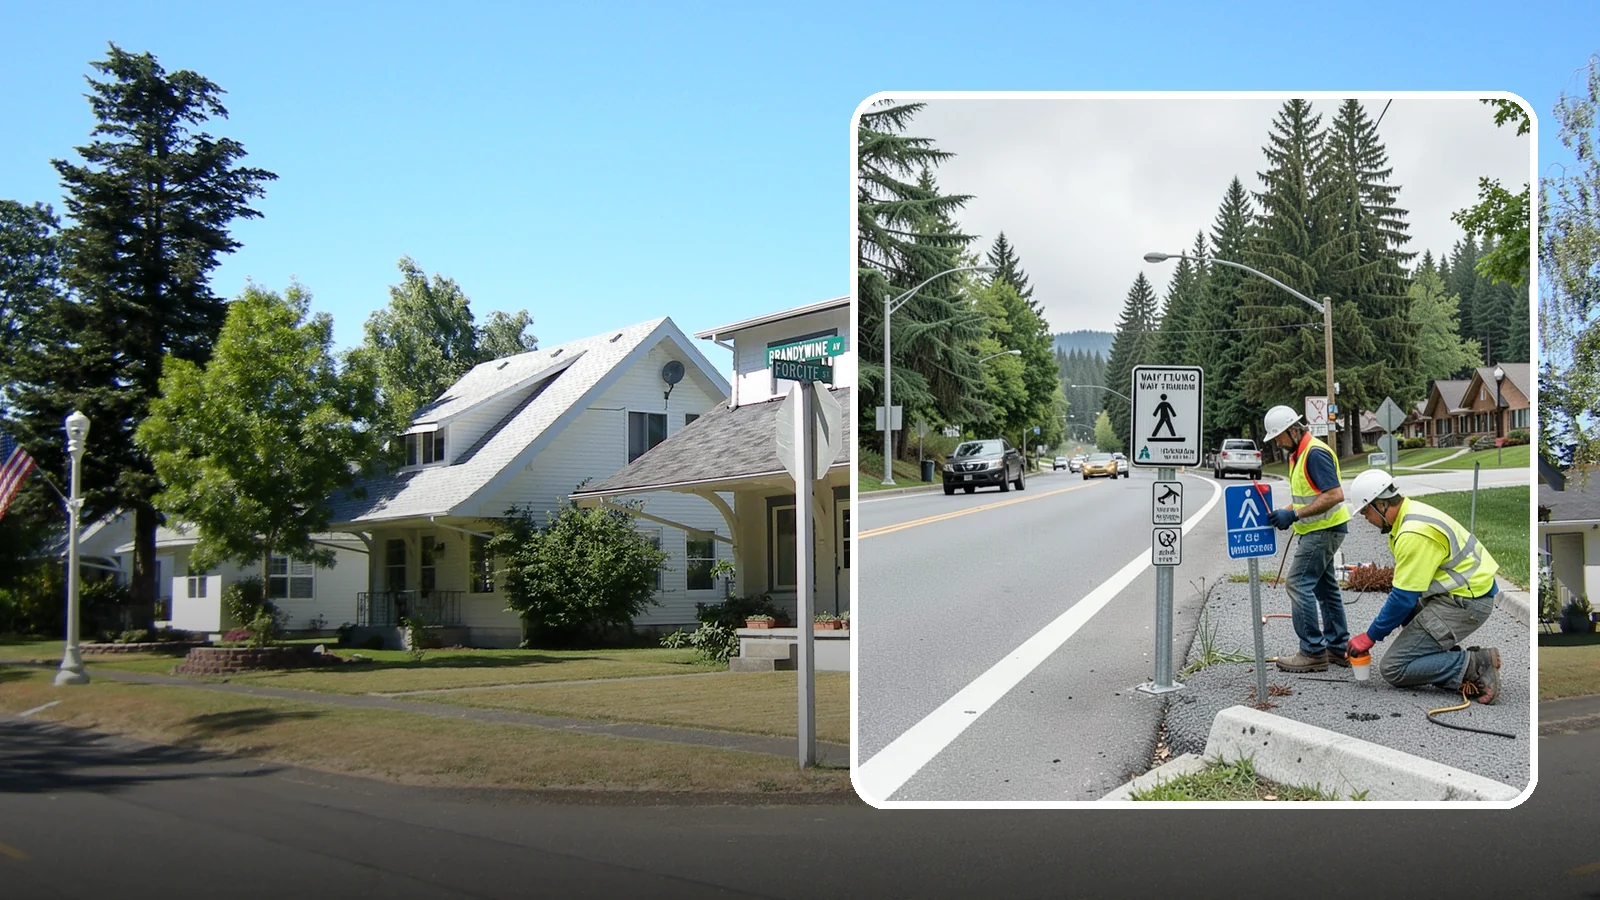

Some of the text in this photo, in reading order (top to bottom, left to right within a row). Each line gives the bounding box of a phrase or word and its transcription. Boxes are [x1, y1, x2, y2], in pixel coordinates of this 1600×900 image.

[769, 341, 841, 364] BRANDYWINE AV
[775, 362, 830, 380] FORCITE ST
